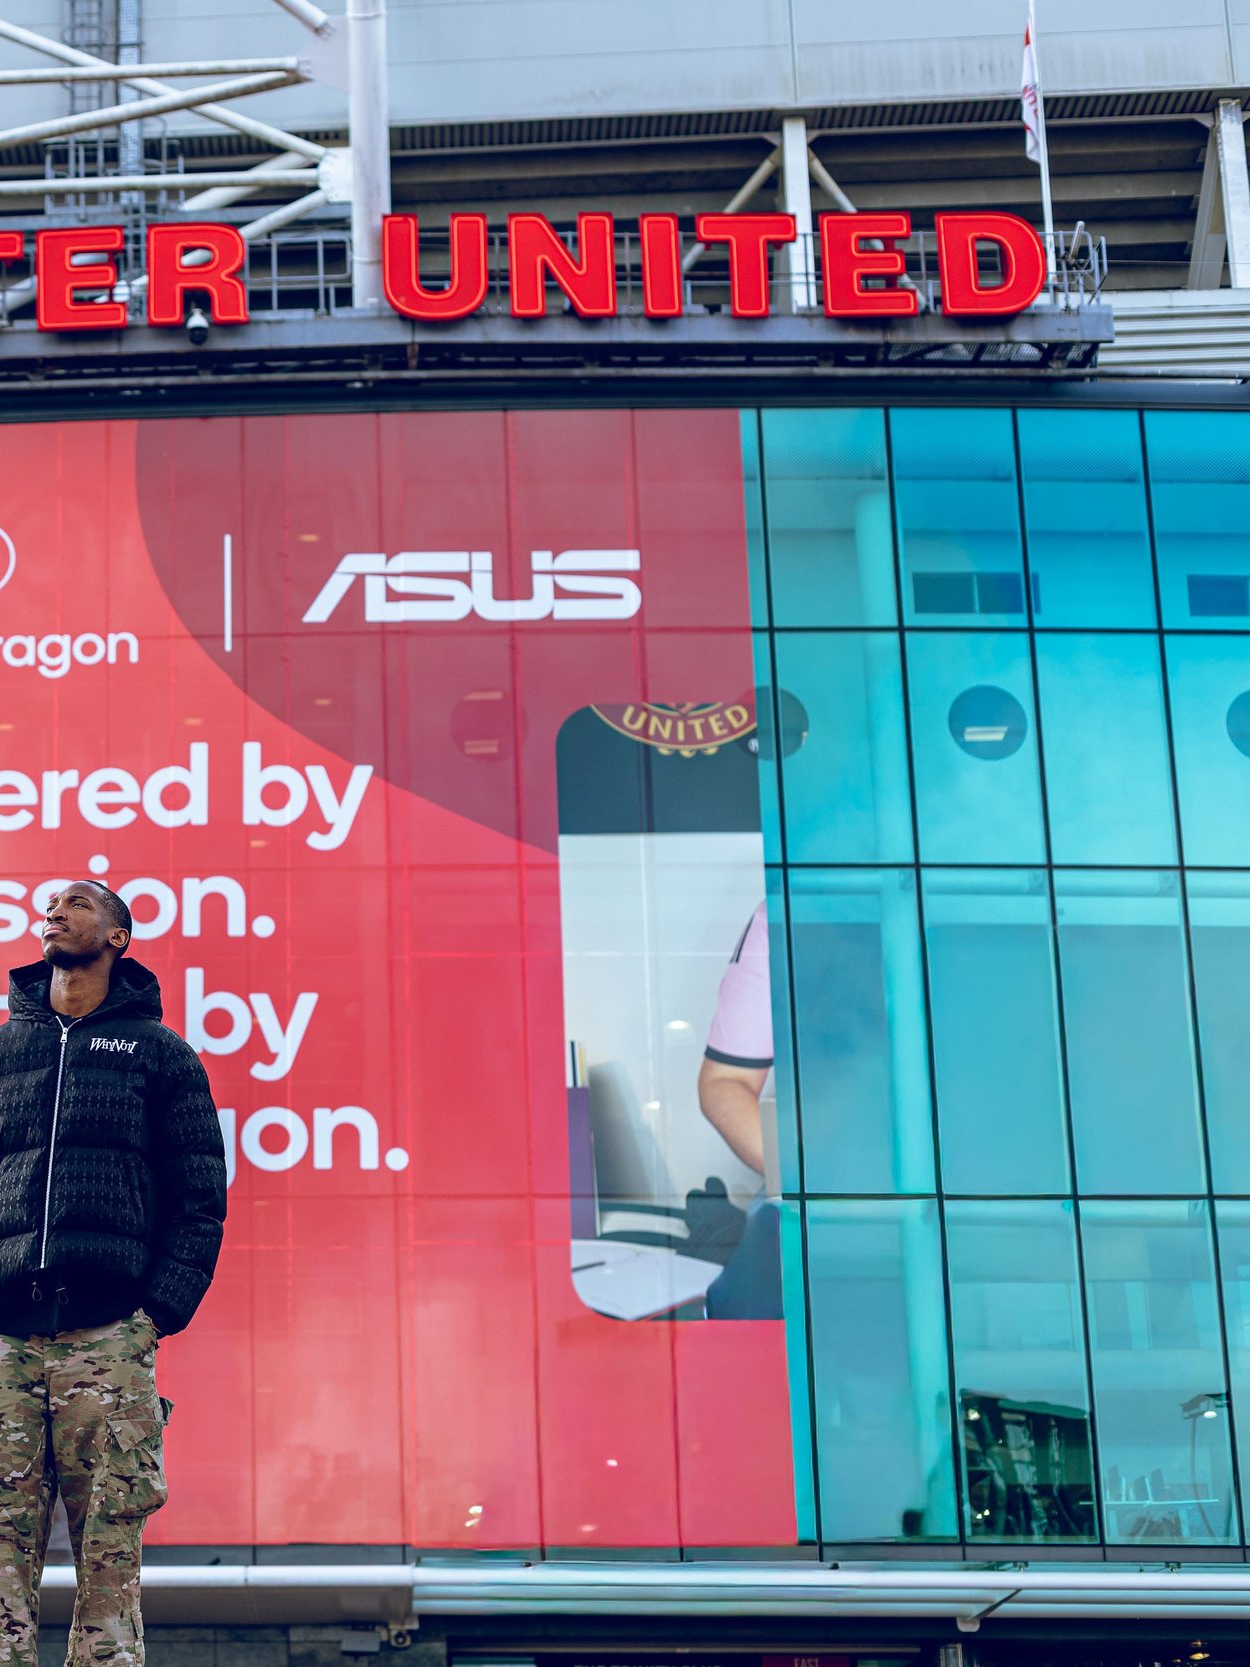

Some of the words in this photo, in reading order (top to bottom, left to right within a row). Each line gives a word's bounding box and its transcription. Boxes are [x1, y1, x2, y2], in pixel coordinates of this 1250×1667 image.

[383, 211, 1047, 320] UNITED
[302, 549, 642, 623] ASUS
[621, 703, 749, 742] UNITED
[242, 741, 374, 851] by
[184, 967, 319, 1082] by
